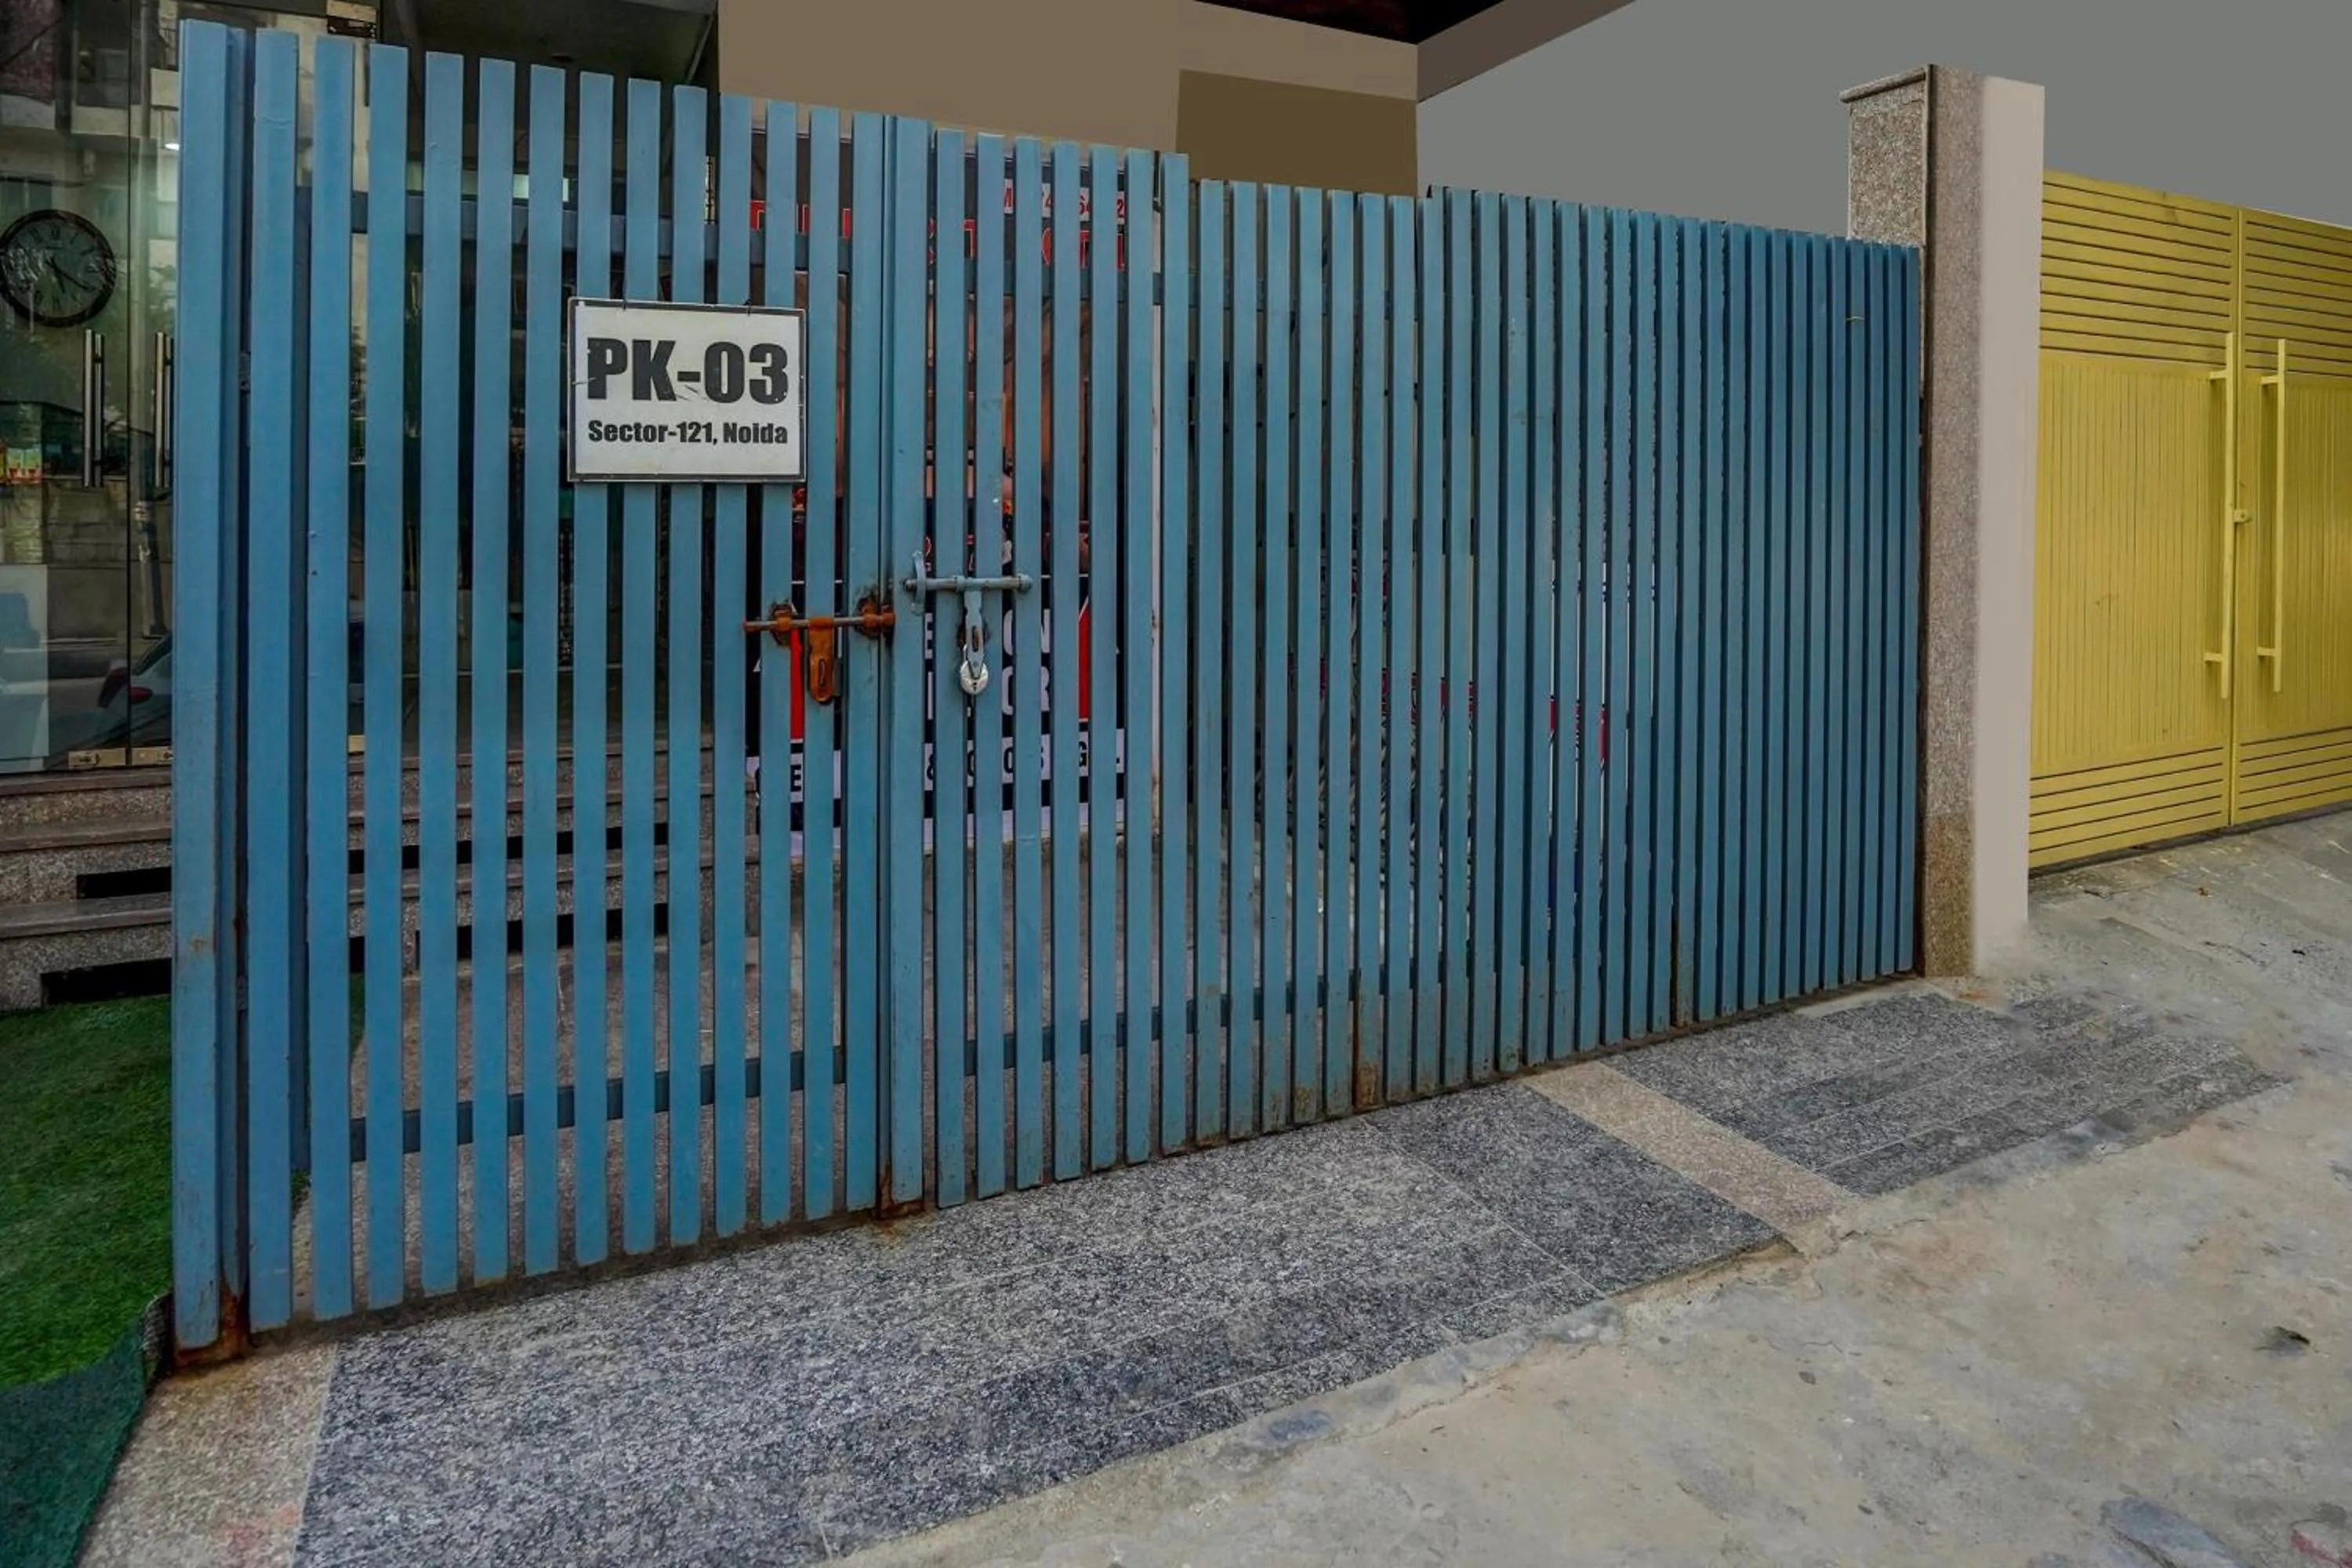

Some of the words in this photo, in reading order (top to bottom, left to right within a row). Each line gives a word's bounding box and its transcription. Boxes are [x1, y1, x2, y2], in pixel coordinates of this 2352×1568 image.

[587, 337, 789, 405] PK-03
[588, 419, 717, 446] Sector-121,
[723, 423, 788, 444] Noida
